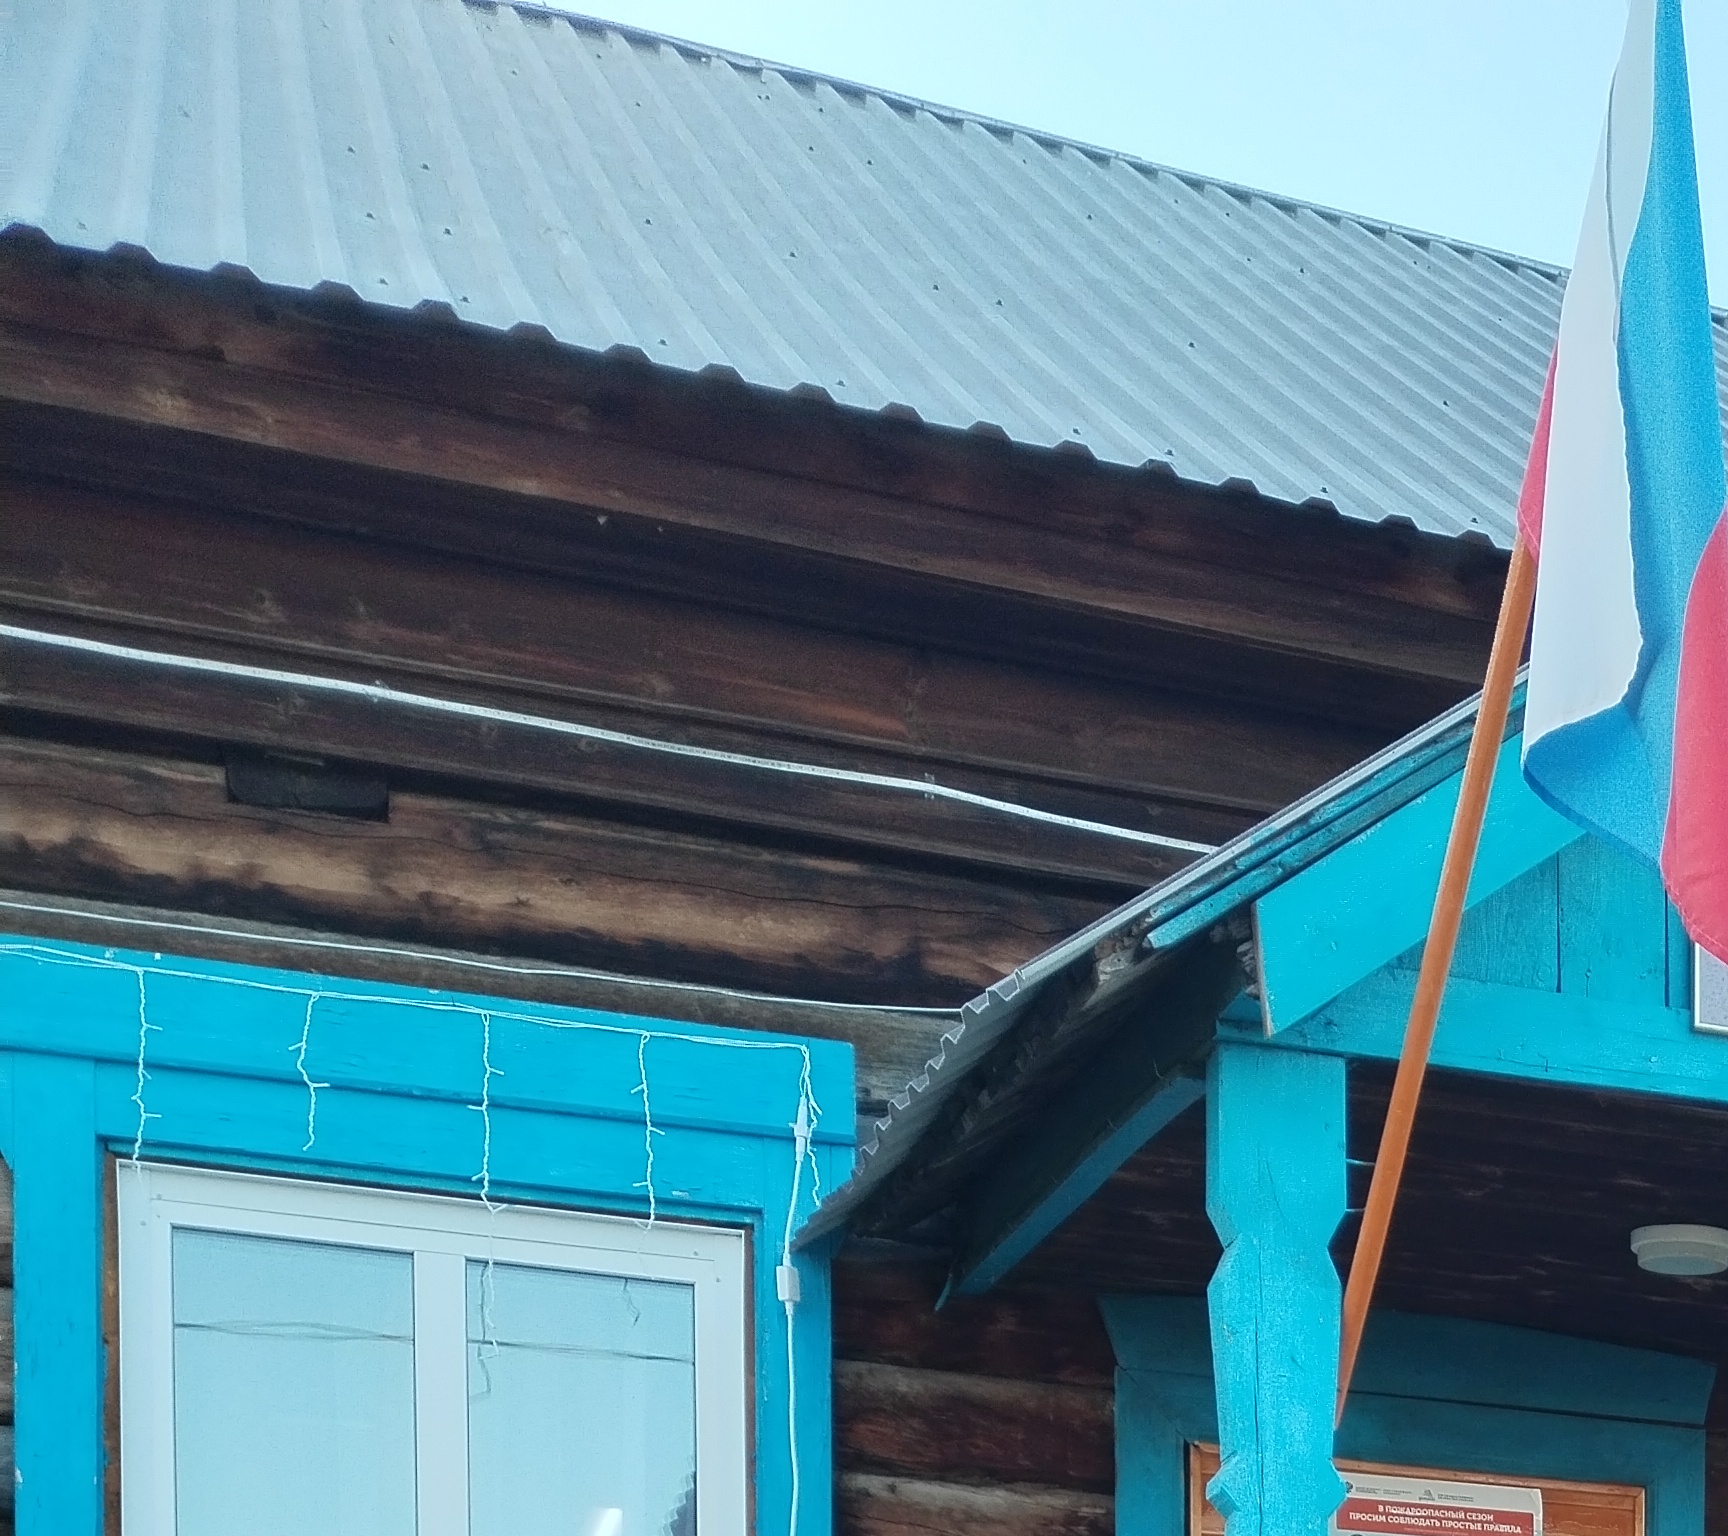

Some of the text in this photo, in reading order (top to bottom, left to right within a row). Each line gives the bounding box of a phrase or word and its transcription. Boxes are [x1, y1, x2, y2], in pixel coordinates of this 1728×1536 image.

[1349, 1511, 1522, 1534] ПРОСИМ СОБЛЮДАТЬ ПРОСТЫЕ ПРАВИЛА
[1385, 1504, 1466, 1520] ПОЖАРООПАСНЫЙ
[1466, 1512, 1494, 1522] СЕЗОН
